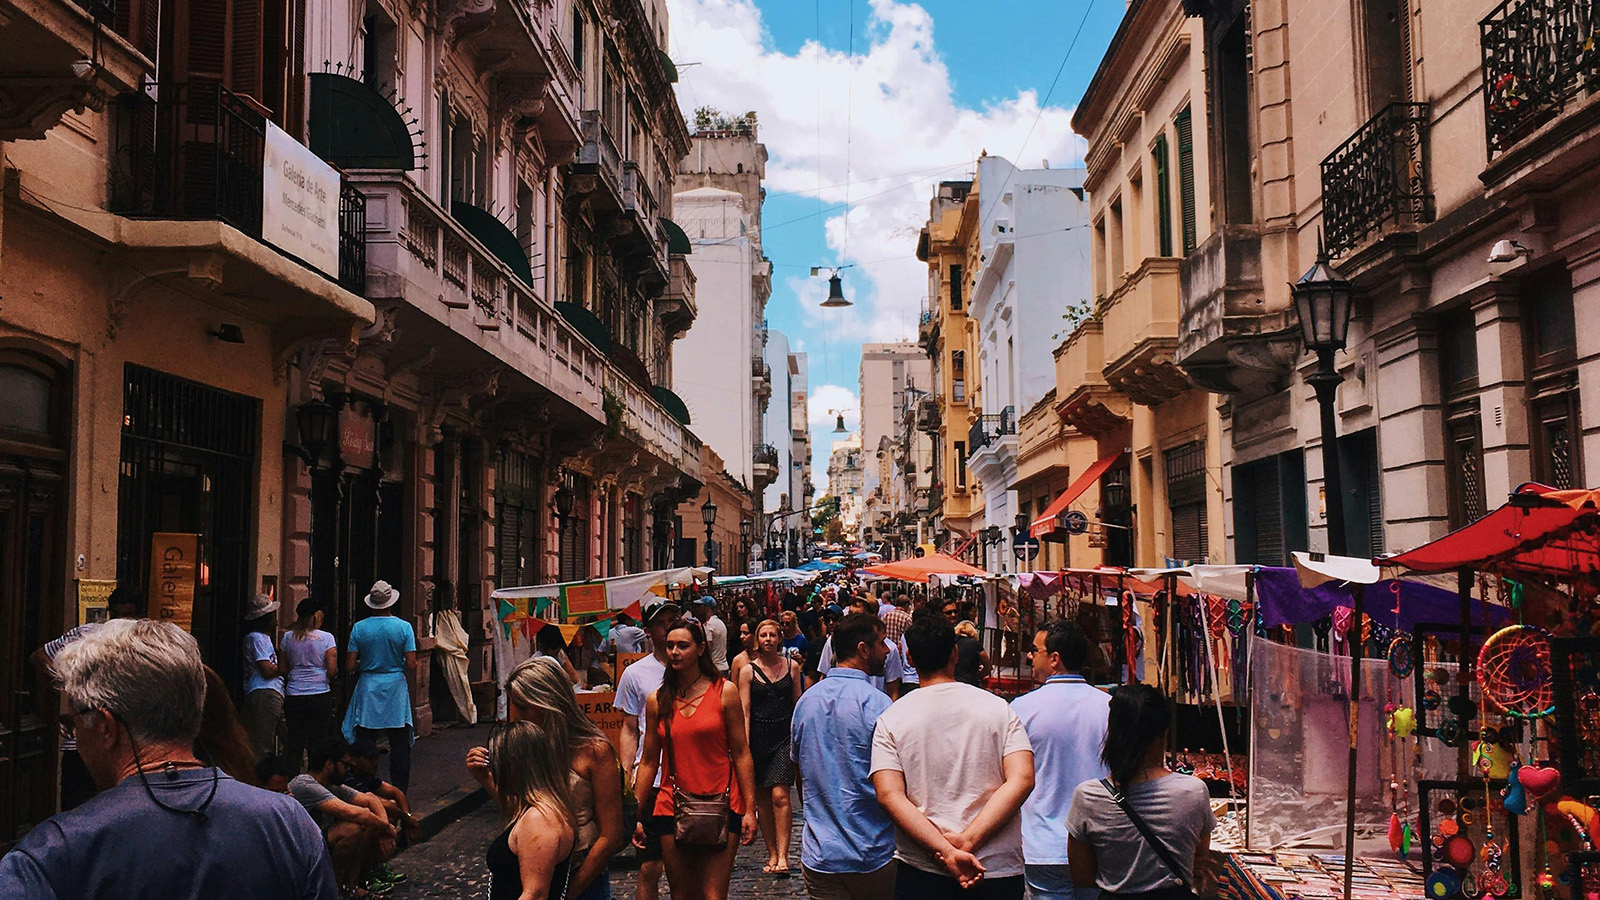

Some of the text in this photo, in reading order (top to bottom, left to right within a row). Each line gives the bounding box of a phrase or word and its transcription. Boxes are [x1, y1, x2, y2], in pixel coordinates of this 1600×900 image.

[282, 191, 306, 217] Mercedes
[314, 181, 326, 204] Arte
[160, 546, 183, 619] Galería
